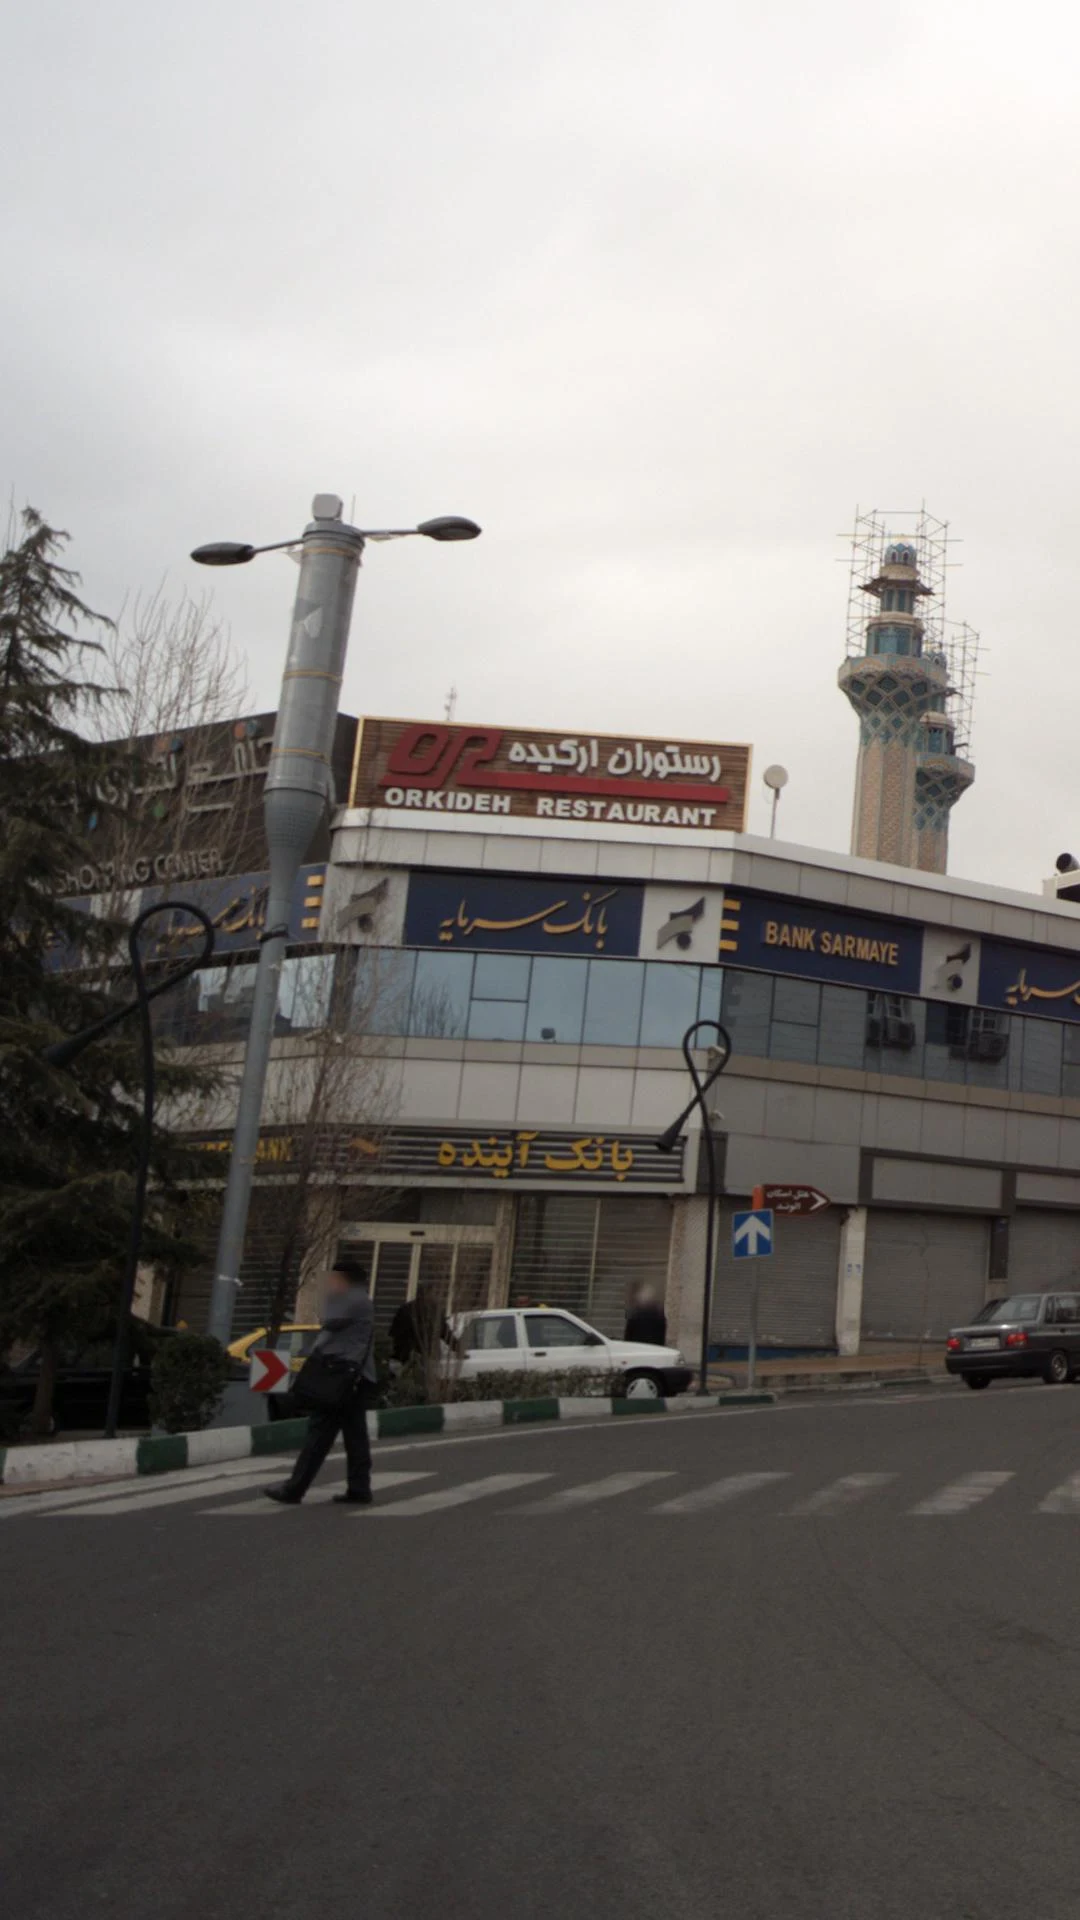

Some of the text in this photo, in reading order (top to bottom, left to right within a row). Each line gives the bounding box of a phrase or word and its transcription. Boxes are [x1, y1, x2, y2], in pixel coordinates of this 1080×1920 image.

[508, 738, 721, 782] رستوران ارکیده
[384, 787, 716, 827] ORKIDEH RESTAURANT
[438, 888, 618, 949] بانک سرمایه
[765, 920, 900, 966] BANK SARMAYE
[437, 1130, 634, 1182] بانک آینده
